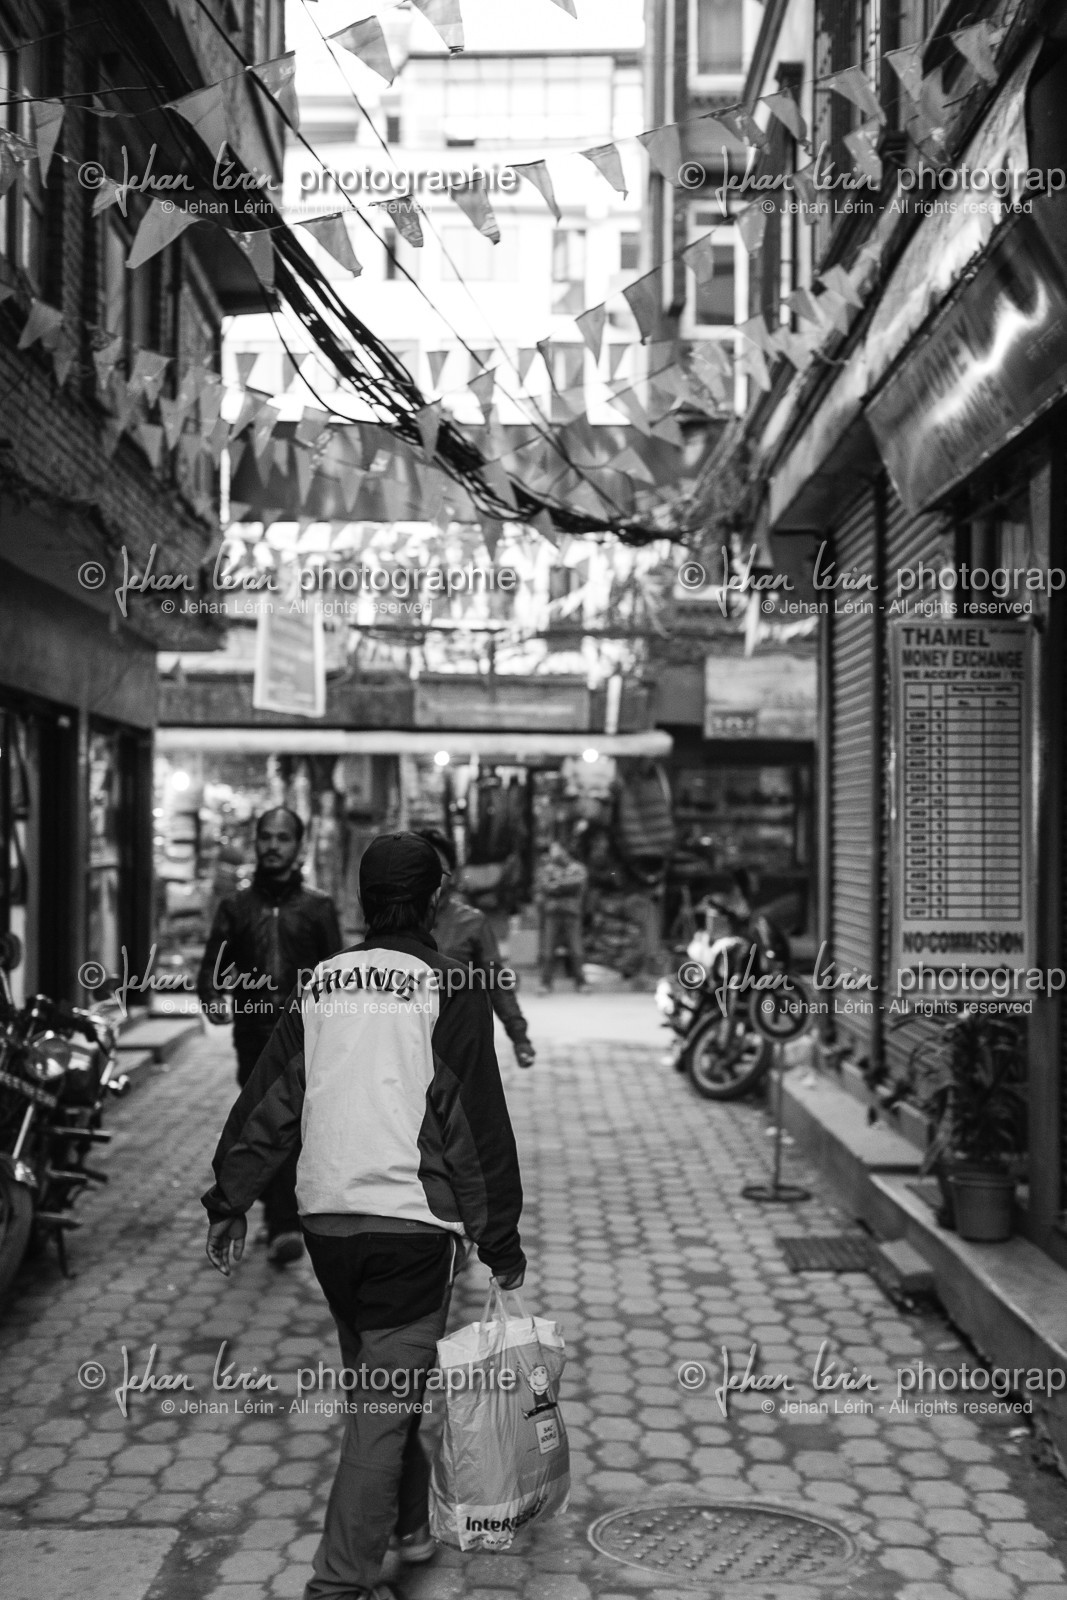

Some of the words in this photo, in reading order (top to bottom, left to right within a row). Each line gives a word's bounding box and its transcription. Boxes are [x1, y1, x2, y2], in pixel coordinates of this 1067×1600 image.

[902, 628, 990, 647] THAMEL
[902, 650, 948, 667] MONEY
[952, 650, 1023, 668] EXCHANGE
[903, 671, 919, 679] WE
[923, 670, 966, 679] ACCEPT
[970, 671, 1001, 679] CASH
[311, 966, 421, 1004] FRANCE
